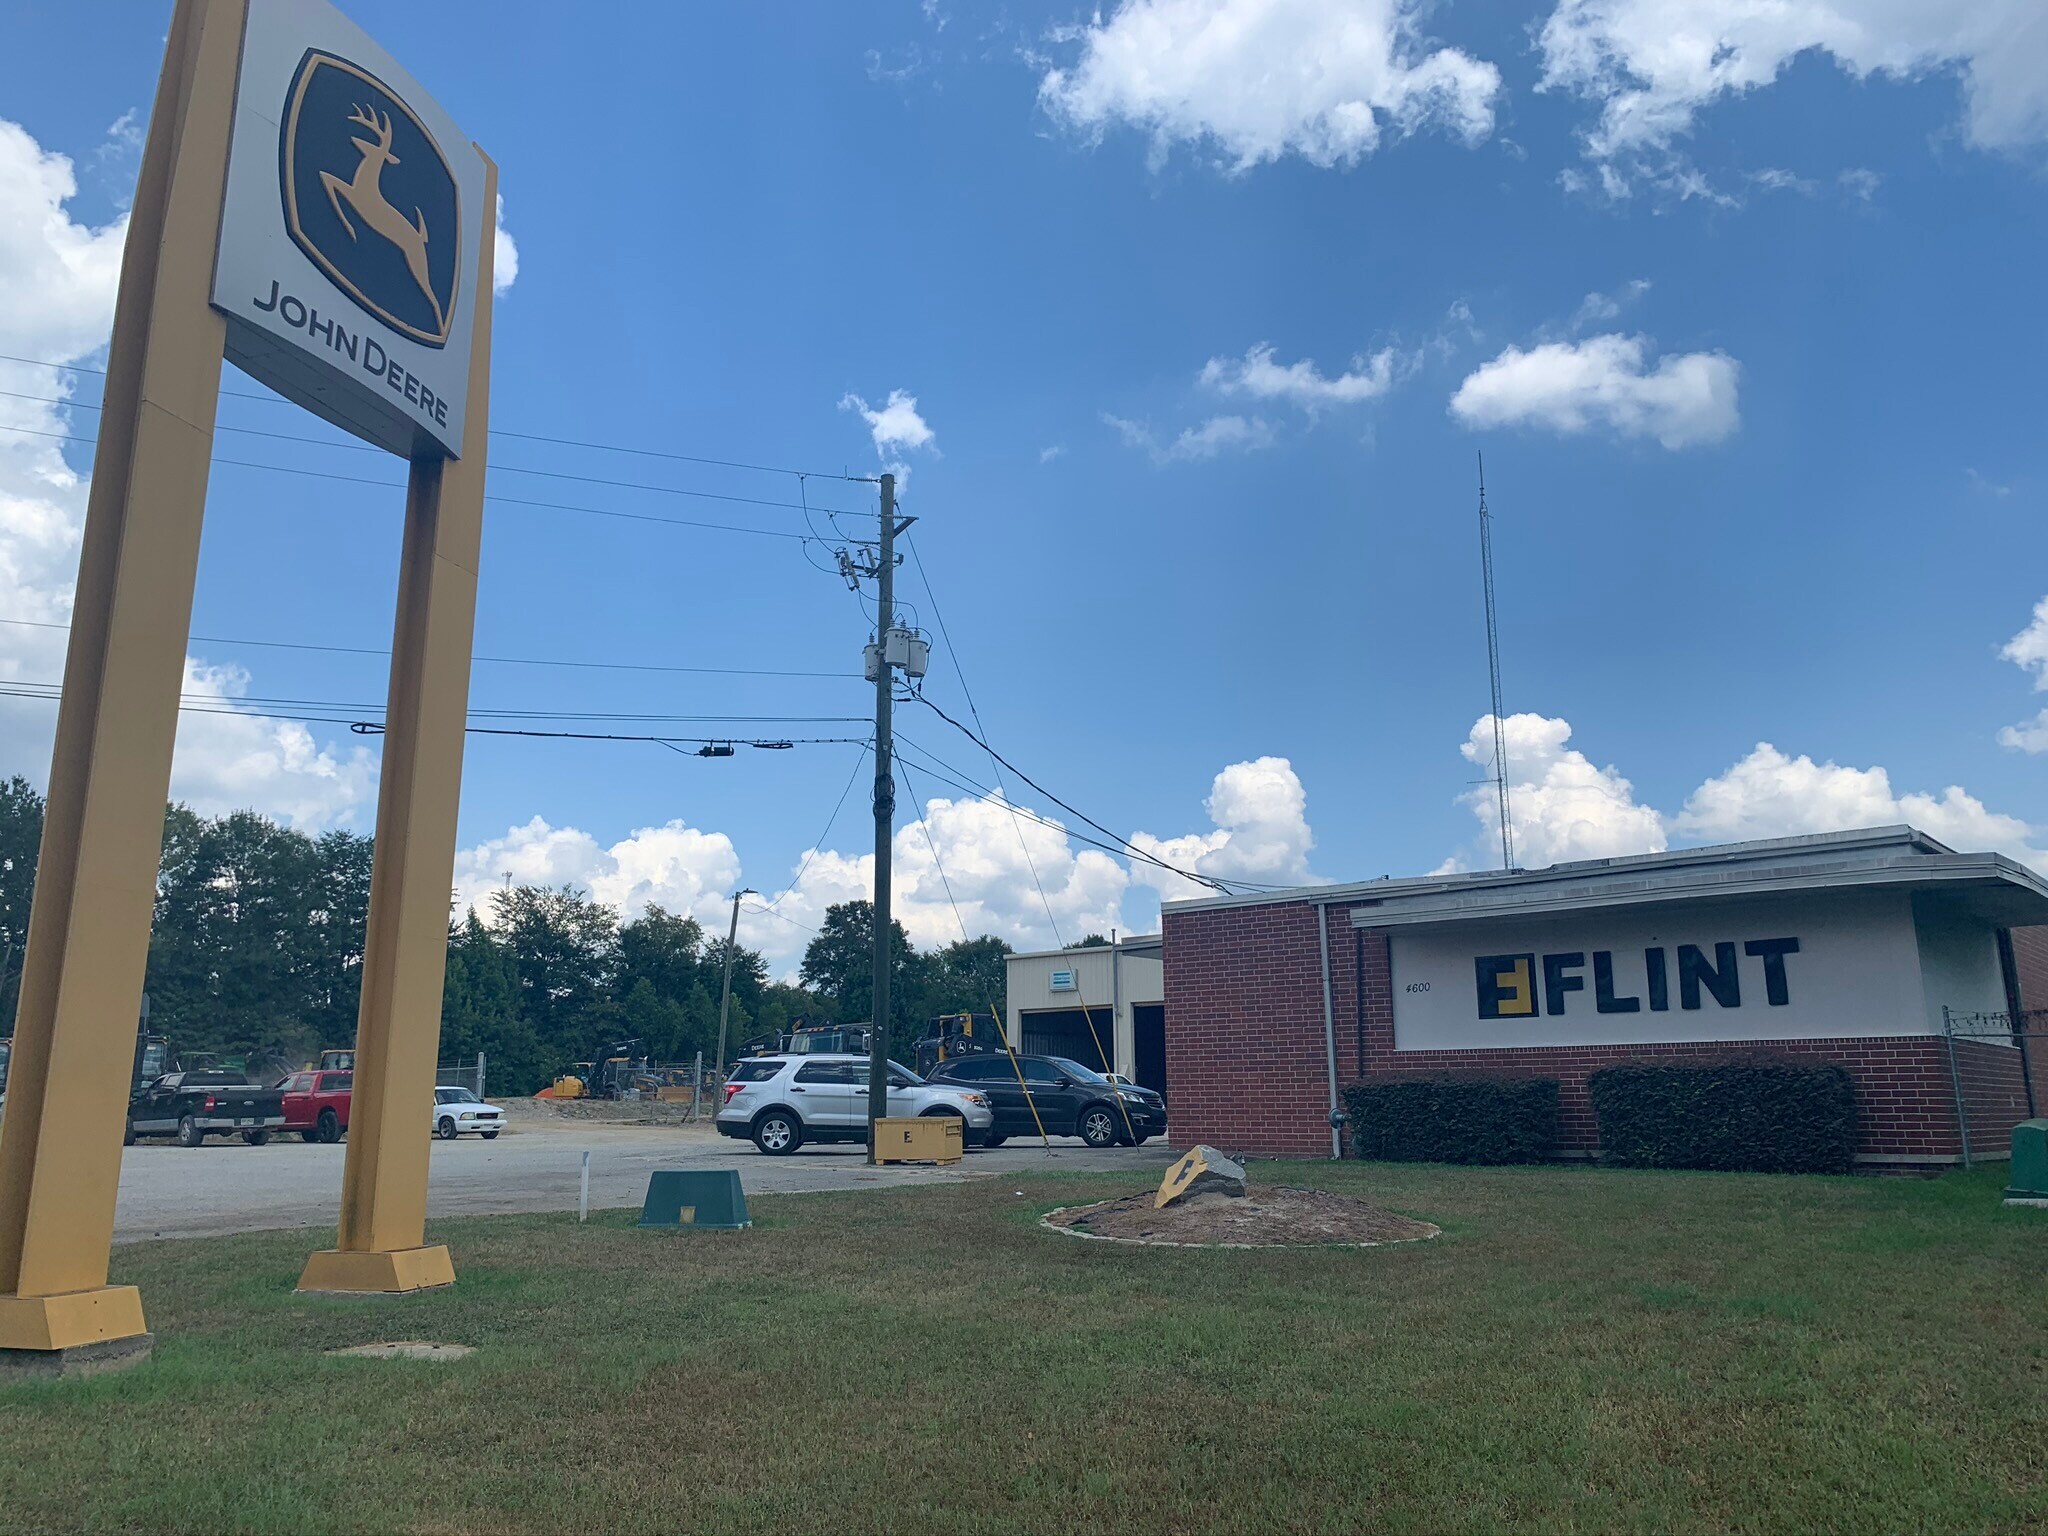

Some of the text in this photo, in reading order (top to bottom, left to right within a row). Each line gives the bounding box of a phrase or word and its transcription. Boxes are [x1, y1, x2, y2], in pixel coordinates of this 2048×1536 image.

[253, 280, 448, 429] JOHN DEERE
[1405, 982, 1431, 993] 4600
[1542, 936, 1800, 1016] FLINT
